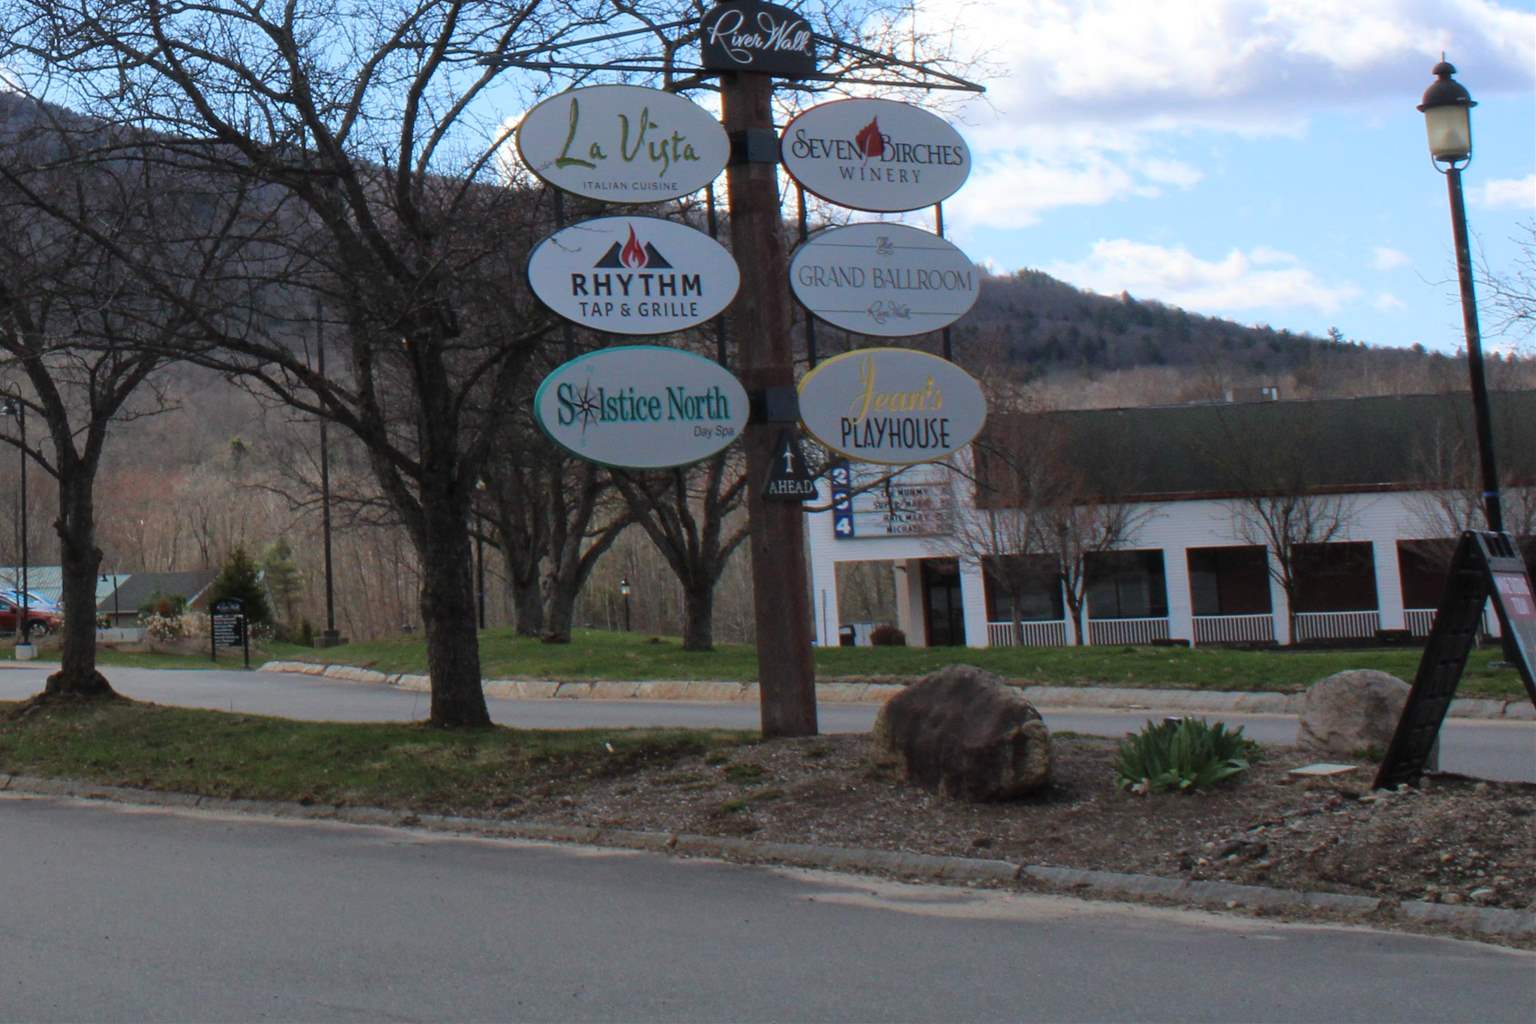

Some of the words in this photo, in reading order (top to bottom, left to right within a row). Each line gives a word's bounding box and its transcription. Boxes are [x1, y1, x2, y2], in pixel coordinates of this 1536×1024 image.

[707, 10, 763, 63] River
[758, 12, 811, 56] Walk
[555, 97, 607, 169] La
[618, 106, 700, 177] Vista
[792, 129, 863, 160] SEVEN
[879, 135, 963, 166] BIRCHES
[583, 181, 628, 191] ITALIAN
[633, 181, 678, 191] CUISINE
[839, 166, 921, 184] WINERY
[570, 273, 703, 297] RHYTHM
[798, 265, 865, 288] GRAND
[872, 267, 972, 291] BALLROOM
[579, 301, 614, 317] TAP
[619, 302, 632, 317] &
[637, 302, 699, 317] GRILLE
[850, 354, 943, 424] Jean's
[665, 386, 731, 420] North
[694, 425, 712, 440] Day
[714, 424, 735, 440] Spa
[841, 417, 950, 449] PLAYHOUSE
[768, 479, 813, 494] AHEAD
[833, 467, 848, 485] 2
[835, 517, 851, 535] 4
